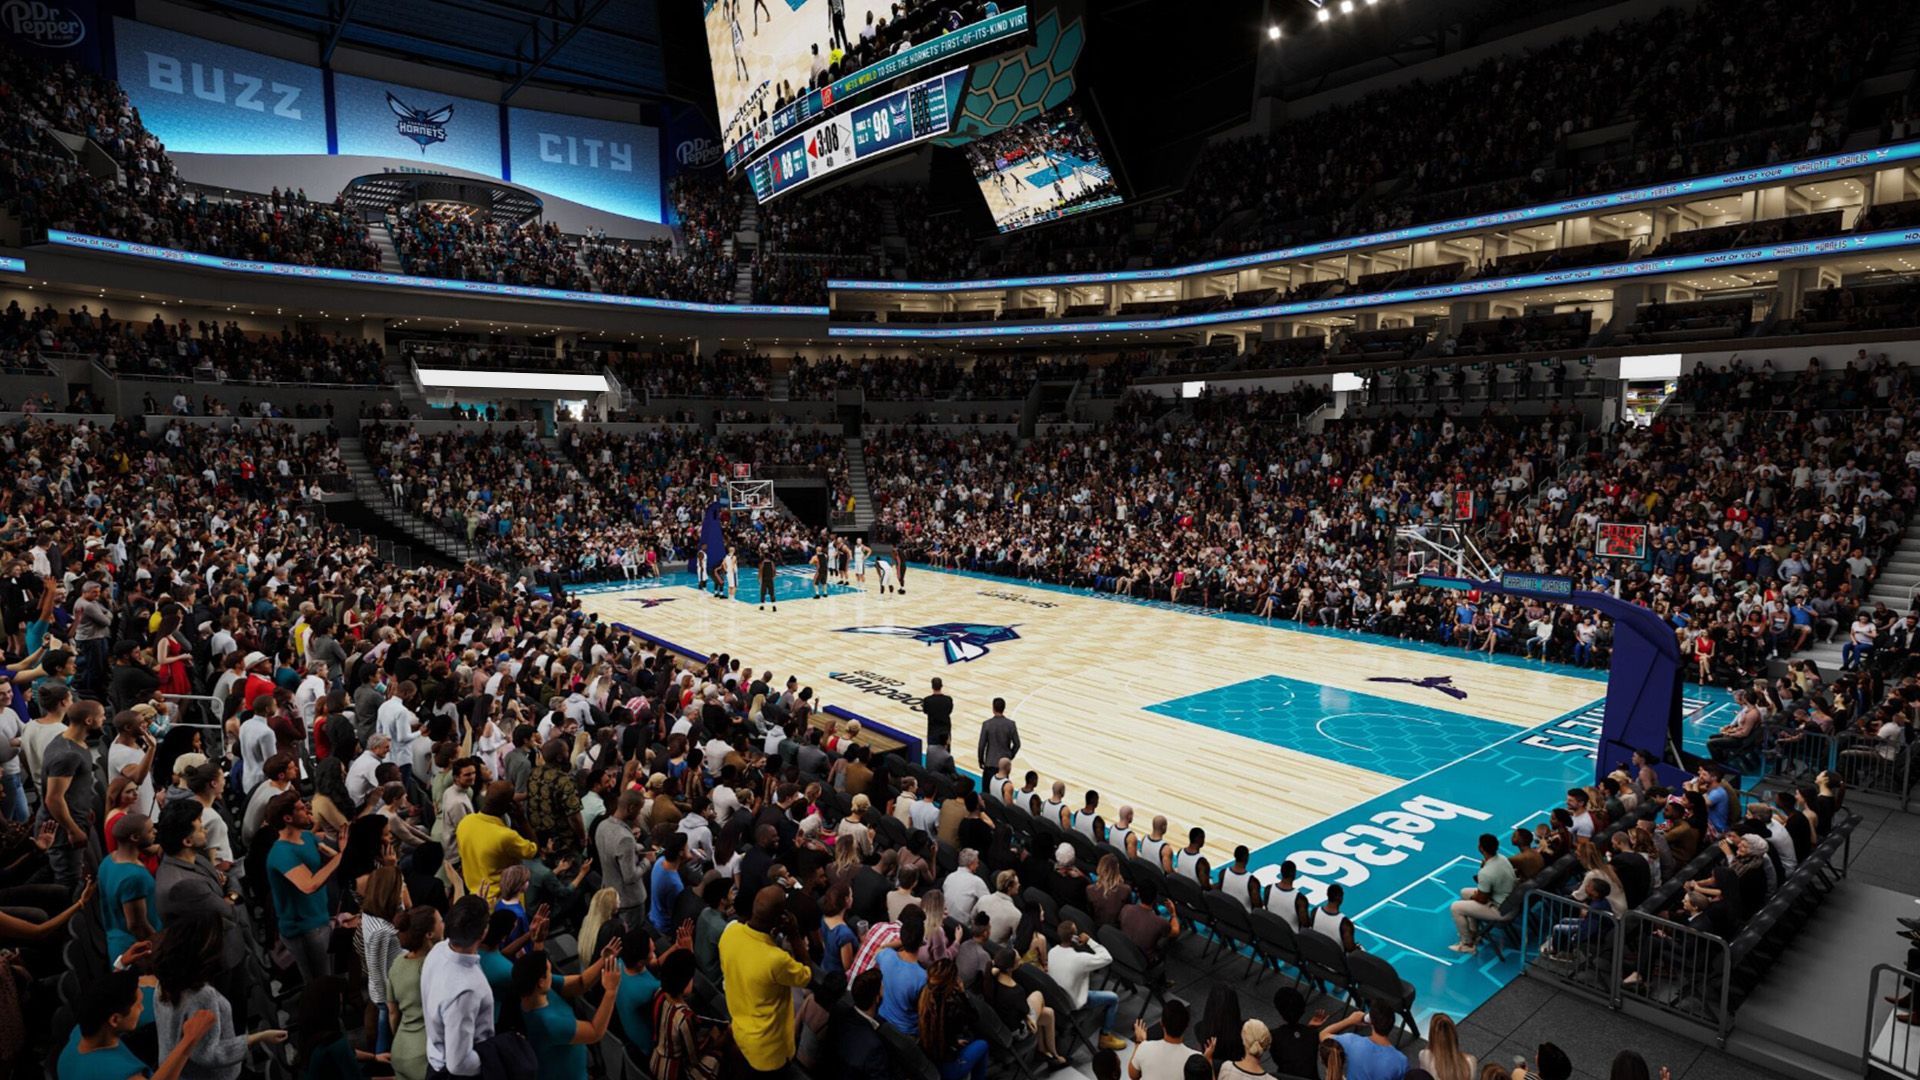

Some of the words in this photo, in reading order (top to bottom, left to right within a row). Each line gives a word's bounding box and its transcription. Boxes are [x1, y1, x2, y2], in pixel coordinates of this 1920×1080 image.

[1, 1, 79, 40] Pepper
[31, 1, 60, 21] Dr
[877, 65, 886, 78] TO
[885, 61, 896, 74] SEE
[898, 56, 908, 69] THE
[940, 20, 1008, 52] FIRST-OF-ITS-KIND
[1008, 13, 1027, 29] VIRT
[144, 51, 302, 120] BUZZ
[399, 122, 445, 139] HORNETS
[872, 108, 890, 142] 98
[694, 138, 711, 152] Dr
[816, 122, 840, 157] 3:08
[539, 132, 632, 172] CITY
[676, 140, 722, 165] Pepper
[781, 151, 793, 180] 88
[1723, 175, 1745, 183] HOME
[1761, 168, 1782, 177] YOUR
[66, 236, 87, 244] HOME
[101, 241, 119, 249] YOUR
[1904, 232, 1920, 240] HO
[1704, 255, 1727, 263] HOME
[1741, 251, 1762, 259] YOUR
[854, 669, 905, 687] CENTER
